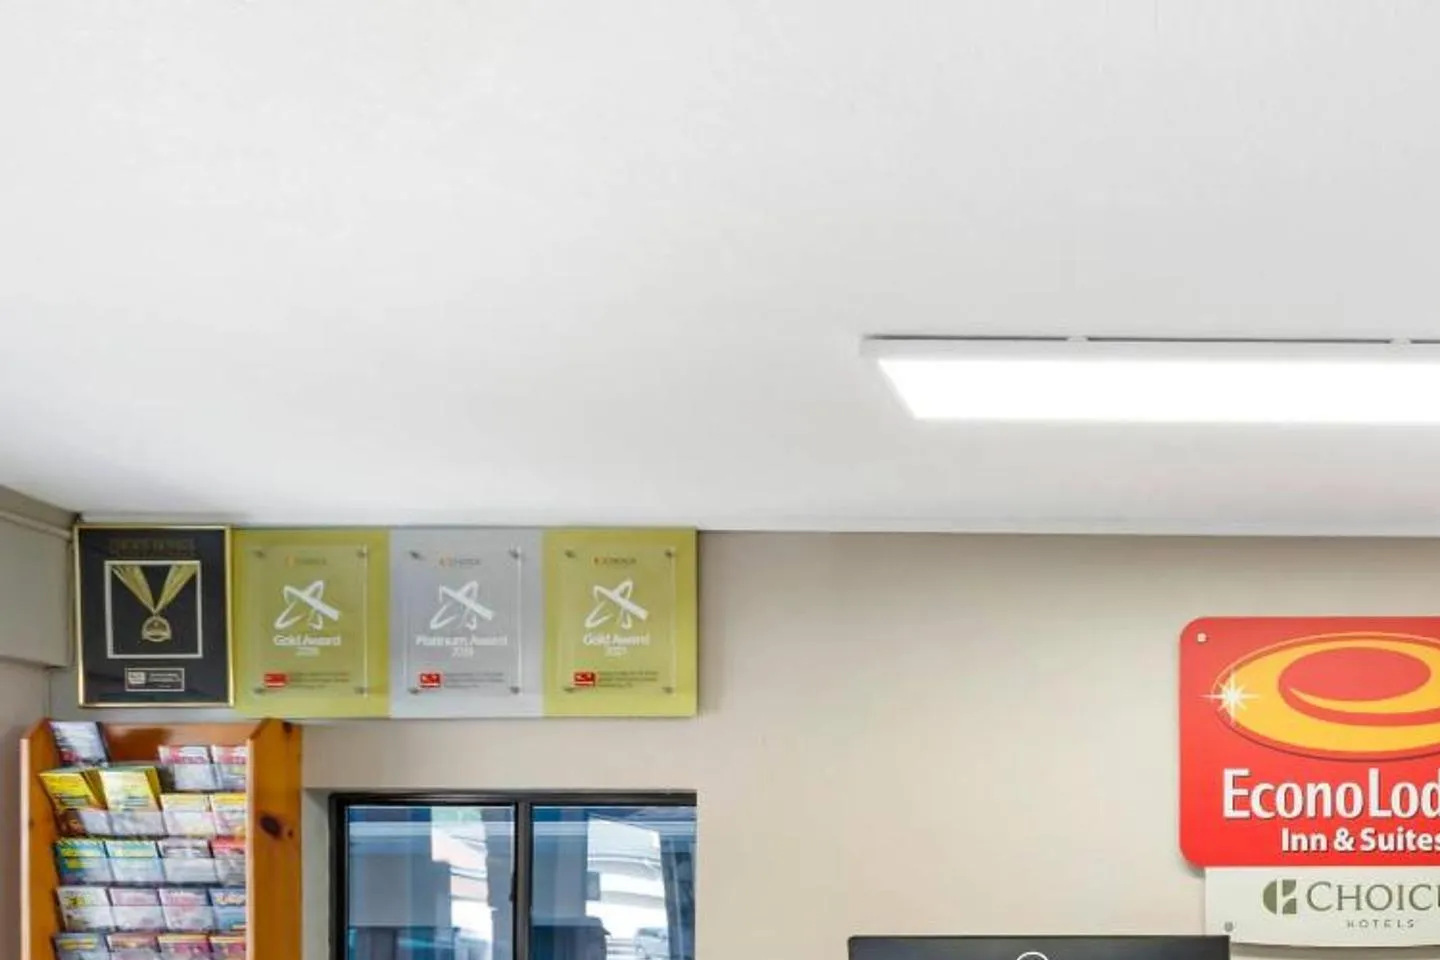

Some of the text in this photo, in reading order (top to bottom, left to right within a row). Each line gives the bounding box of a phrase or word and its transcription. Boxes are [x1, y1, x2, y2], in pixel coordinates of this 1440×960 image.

[1281, 826, 1329, 853] Inn
[1333, 826, 1356, 853] &
[1346, 918, 1416, 929] HOTELS
